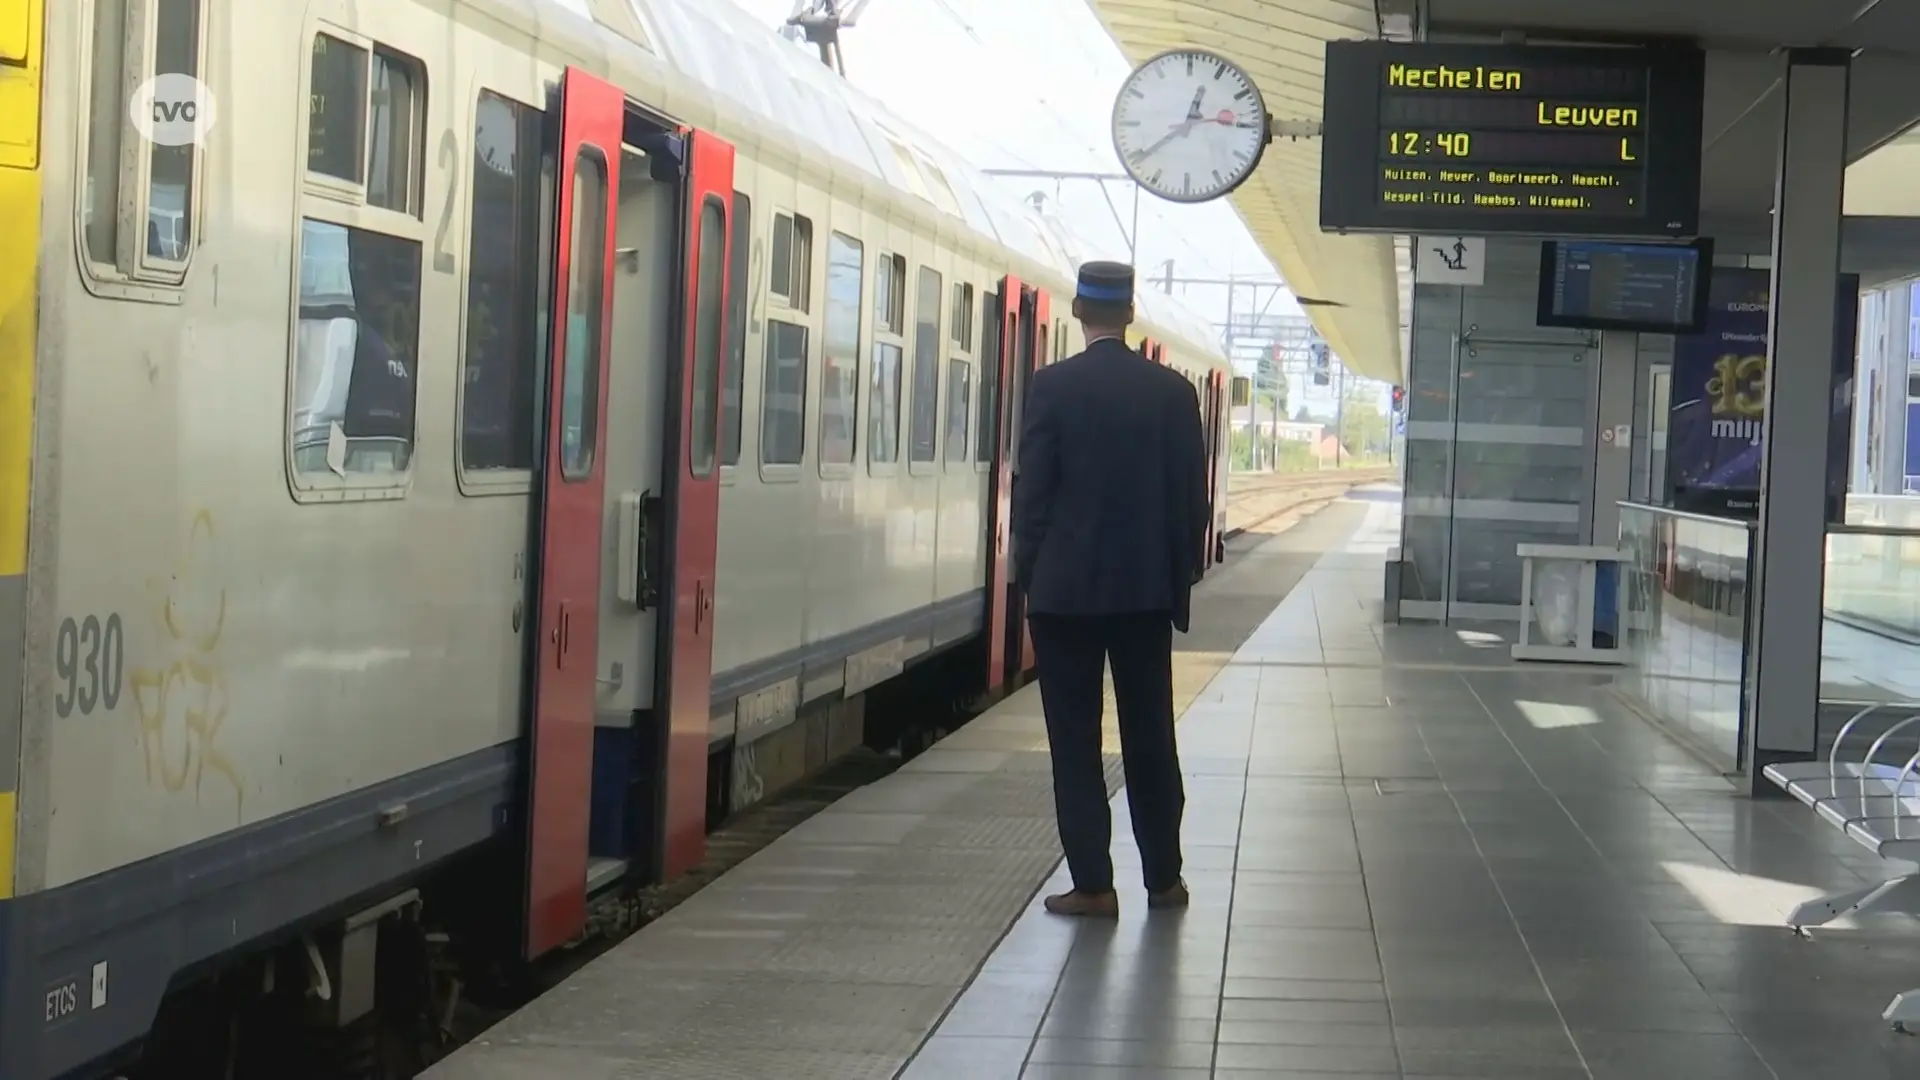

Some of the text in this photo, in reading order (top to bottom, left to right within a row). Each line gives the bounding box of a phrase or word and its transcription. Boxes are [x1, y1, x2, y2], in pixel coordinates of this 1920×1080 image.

[1389, 63, 1521, 90] Mechelen
[1538, 101, 1638, 126] Leuven
[1390, 131, 1636, 160] 12:40 L
[432, 127, 459, 275] 2
[749, 237, 763, 334] 2
[1705, 354, 1767, 417] 13
[1711, 419, 1763, 446] milj
[56, 612, 123, 719] 930
[46, 981, 77, 1022] ETCS
